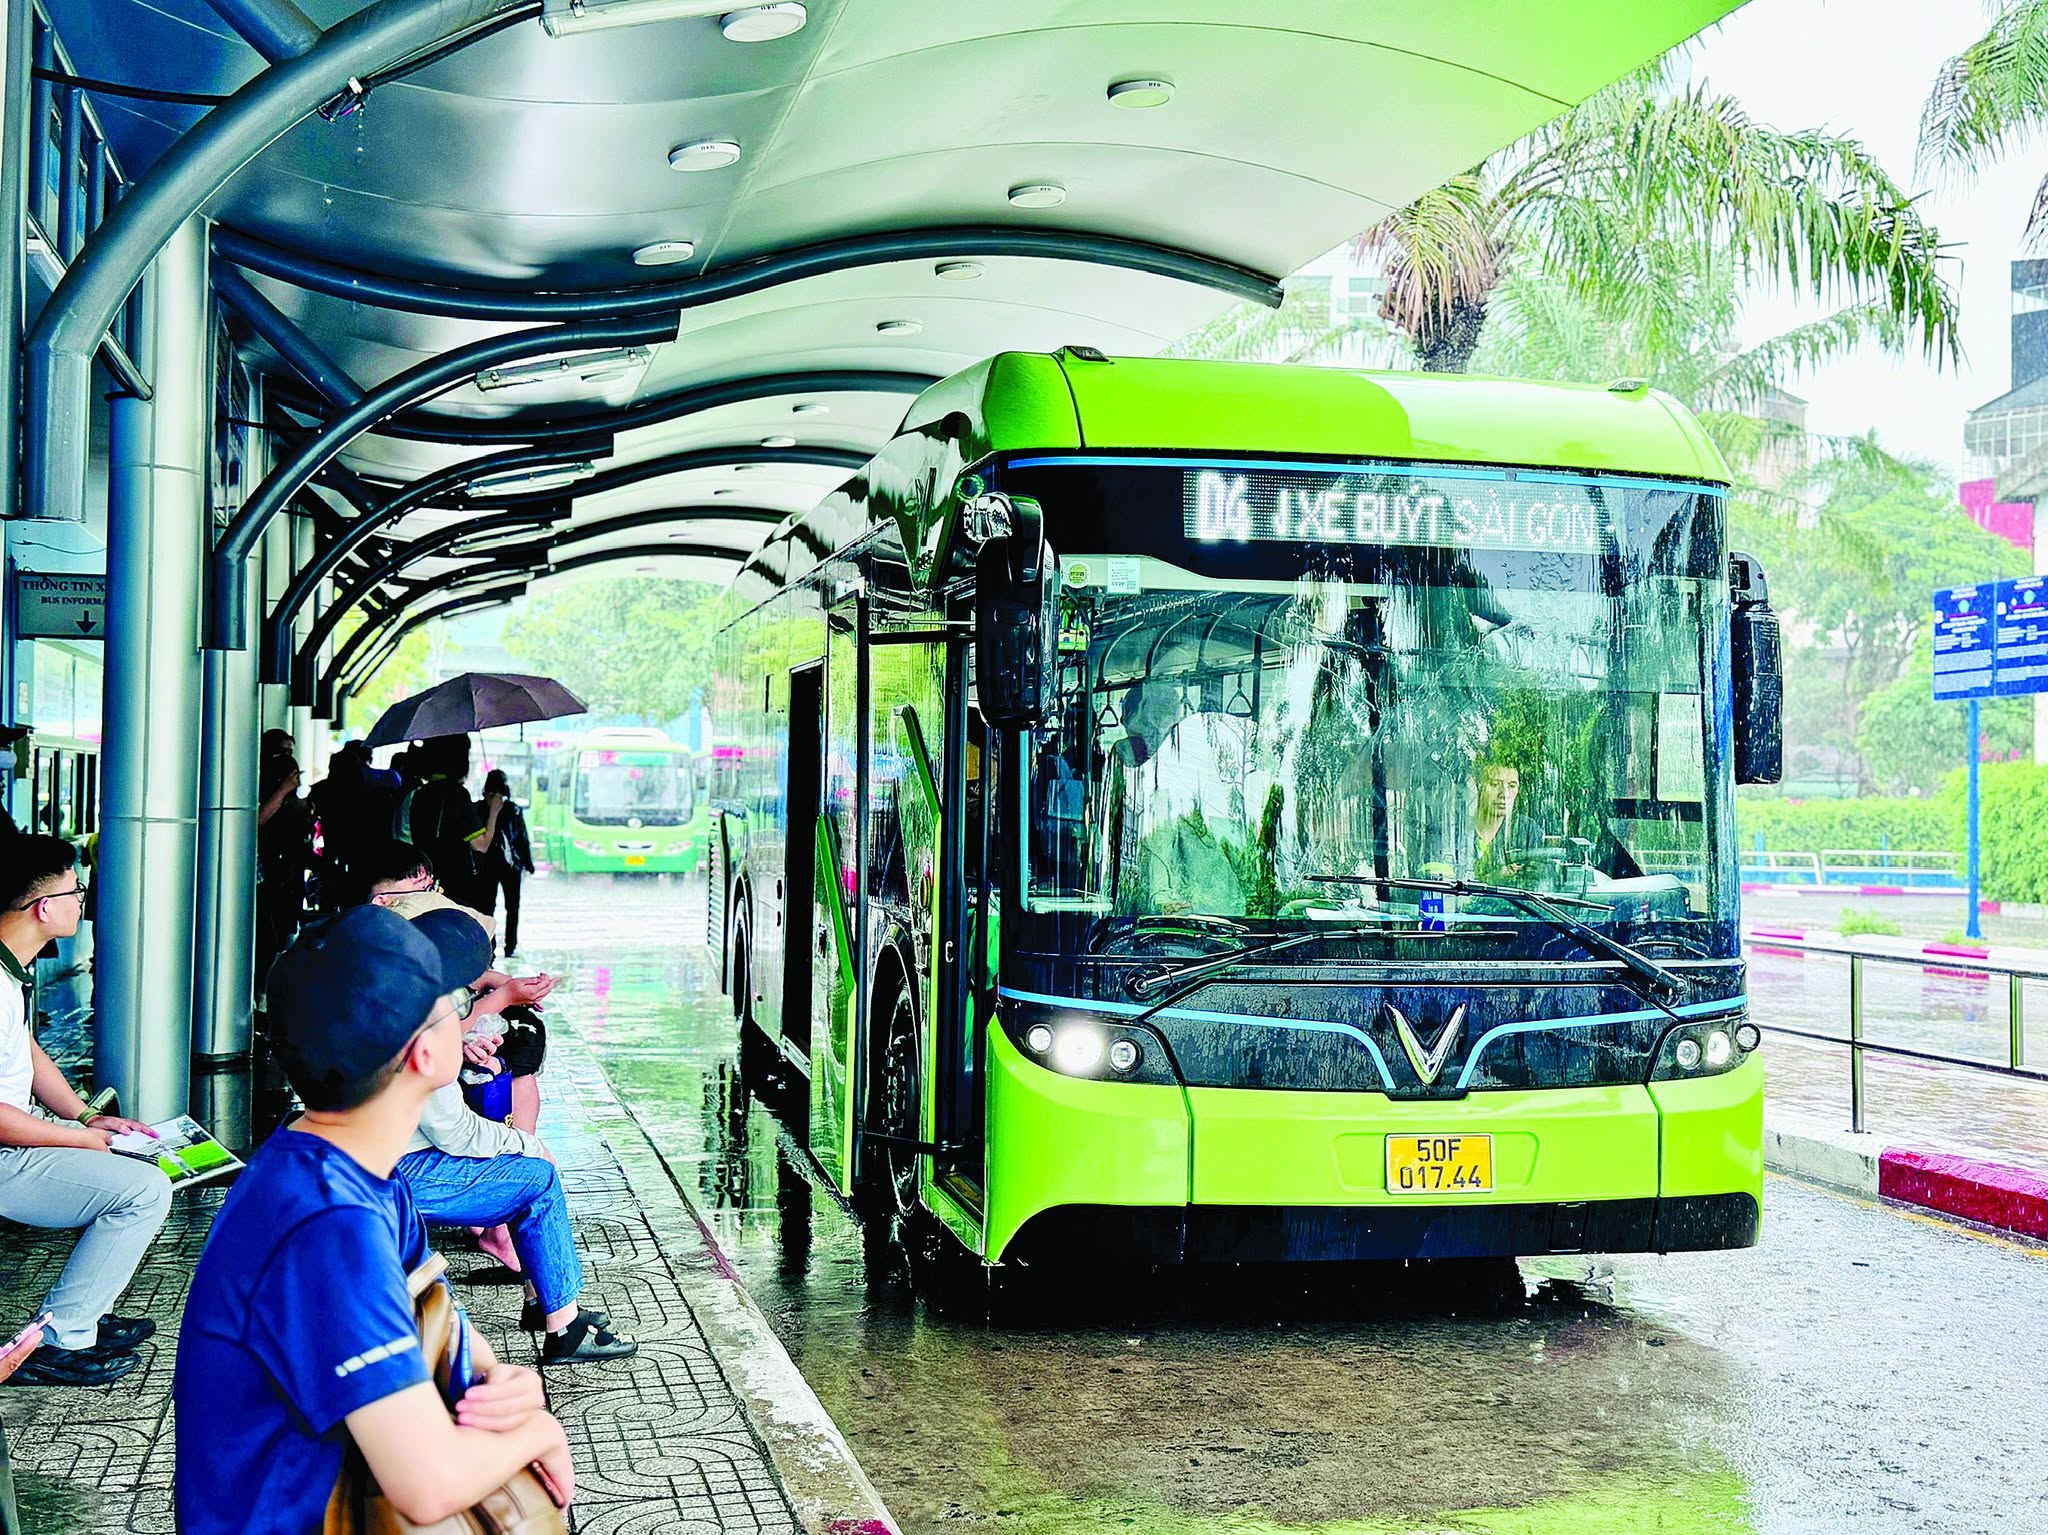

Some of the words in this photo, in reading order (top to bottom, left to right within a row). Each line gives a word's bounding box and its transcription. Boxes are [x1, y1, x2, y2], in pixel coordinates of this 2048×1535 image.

[1299, 490, 1346, 538] XE
[71, 581, 94, 592] TIN
[1417, 1139, 1461, 1162] 50F
[1400, 1165, 1481, 1189] 017.44
